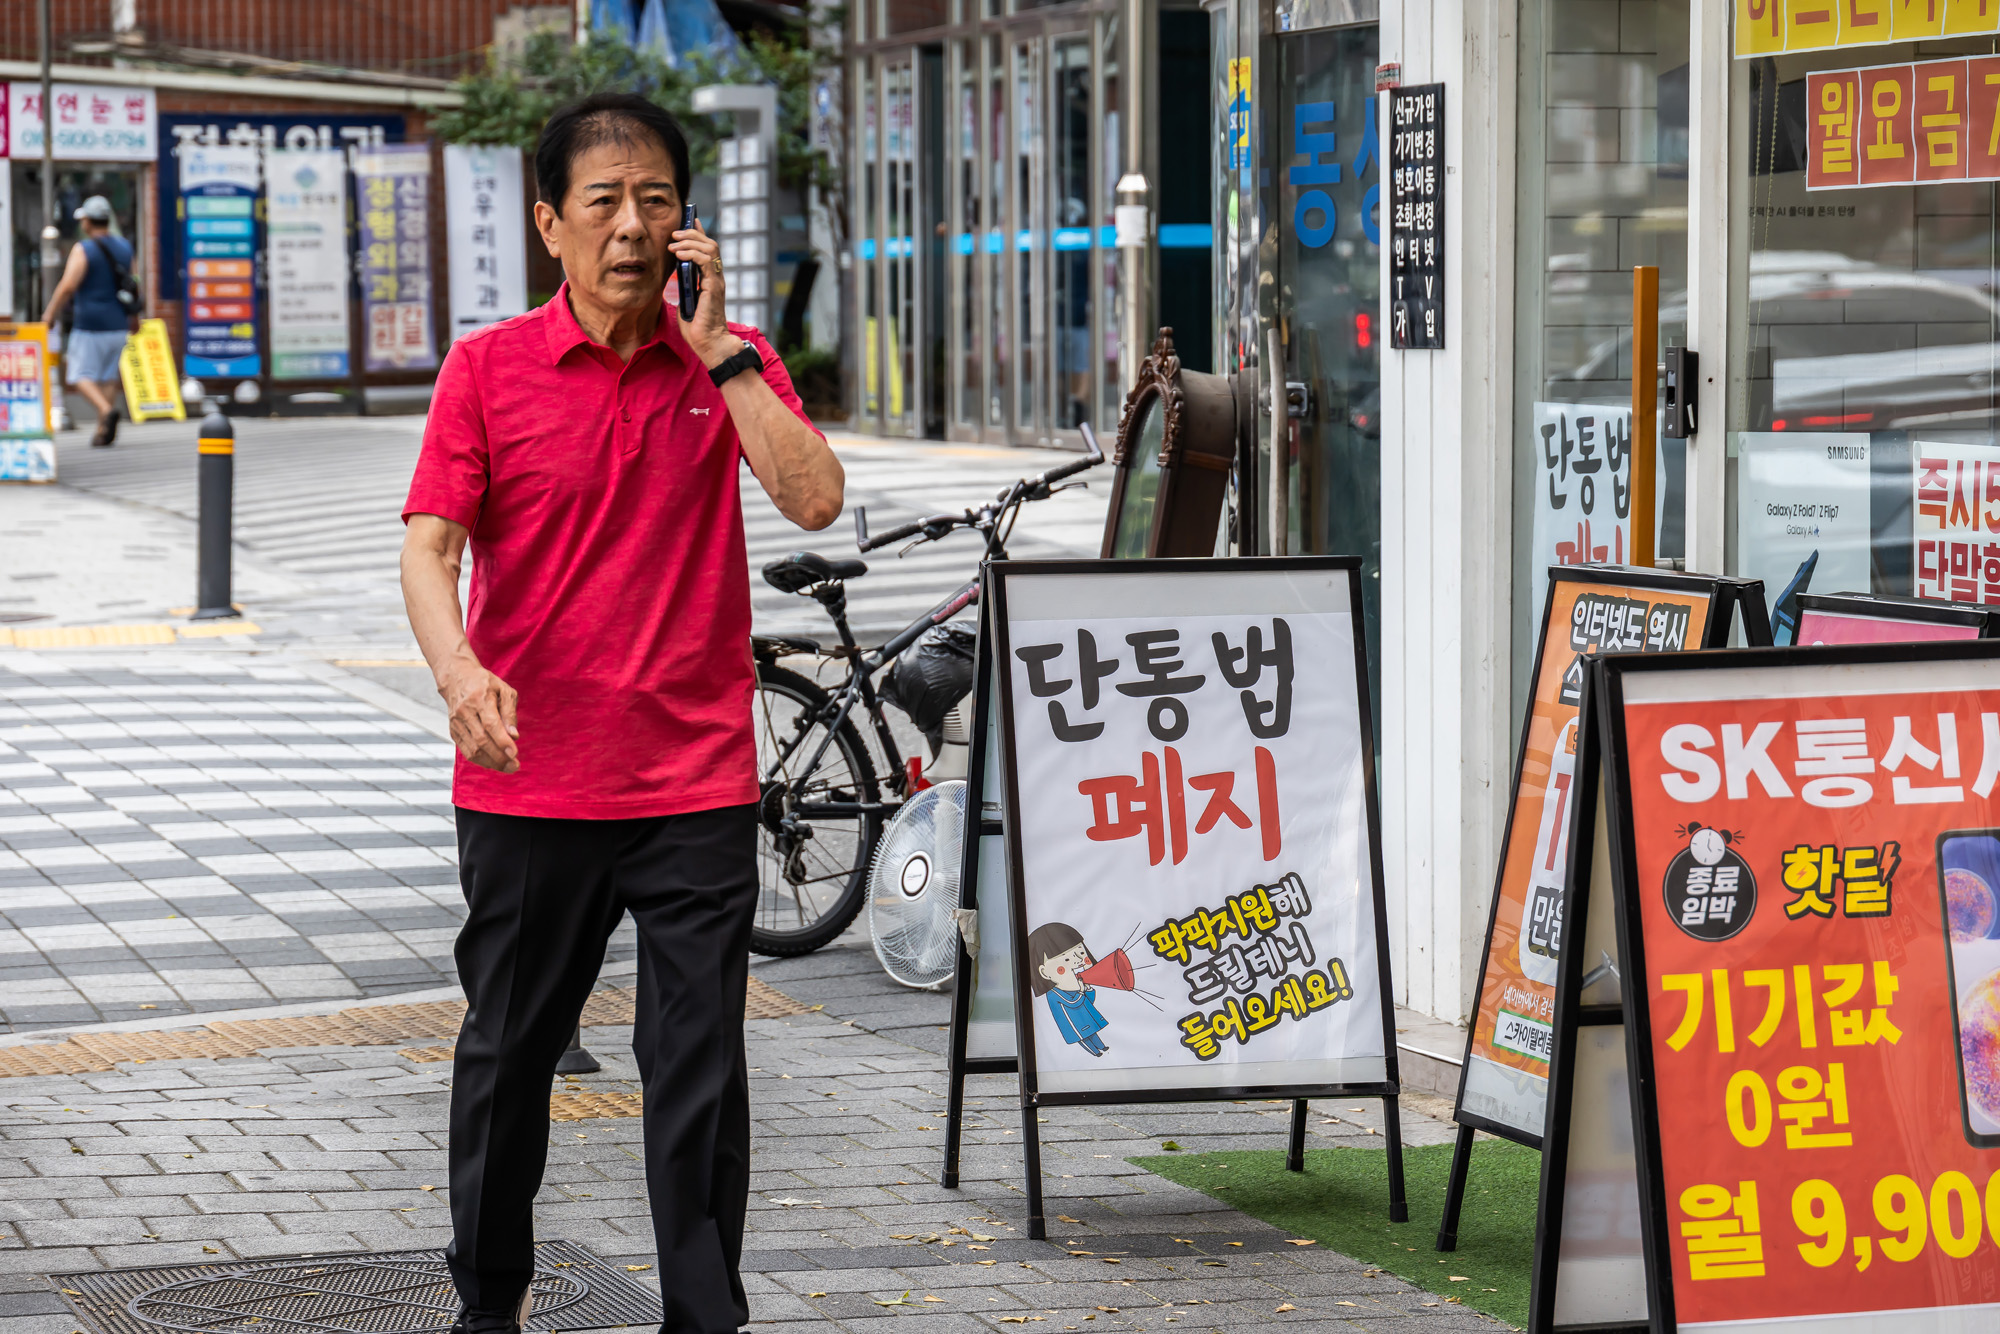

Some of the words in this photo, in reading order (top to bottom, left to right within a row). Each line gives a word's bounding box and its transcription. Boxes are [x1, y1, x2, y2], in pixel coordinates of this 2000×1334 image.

[1395, 93, 1435, 125] 신규가입
[1818, 75, 1961, 174] 월요금
[1395, 129, 1435, 160] 기기변경
[1395, 165, 1435, 196] 번호이동
[1776, 206, 1786, 216] AI
[1395, 237, 1435, 267] 인터넷
[1827, 446, 1865, 461] SAMSUNG
[1767, 503, 1792, 520] Galaxy
[1793, 504, 1797, 517] Z
[1799, 504, 1816, 517] Fold7
[1820, 505, 1823, 518] Z
[1824, 504, 1839, 522] Flip7
[1786, 524, 1807, 538] Galaxy
[1808, 526, 1813, 535] AI
[1572, 599, 1645, 651] 인터넷도
[1648, 610, 1687, 652] 역시
[1015, 617, 1296, 743] 단통법
[1077, 745, 1282, 867] 폐지
[1686, 866, 1740, 895] 종료
[1149, 874, 1311, 965] 팍팍지원해
[1681, 896, 1737, 926] 임박
[1185, 923, 1314, 1004] 드릴테니
[1178, 959, 1351, 1059] 들어오세요!
[1661, 960, 1903, 1053] 기기값
[1725, 1062, 1853, 1149] 0원
[1679, 1180, 1766, 1281] 월
